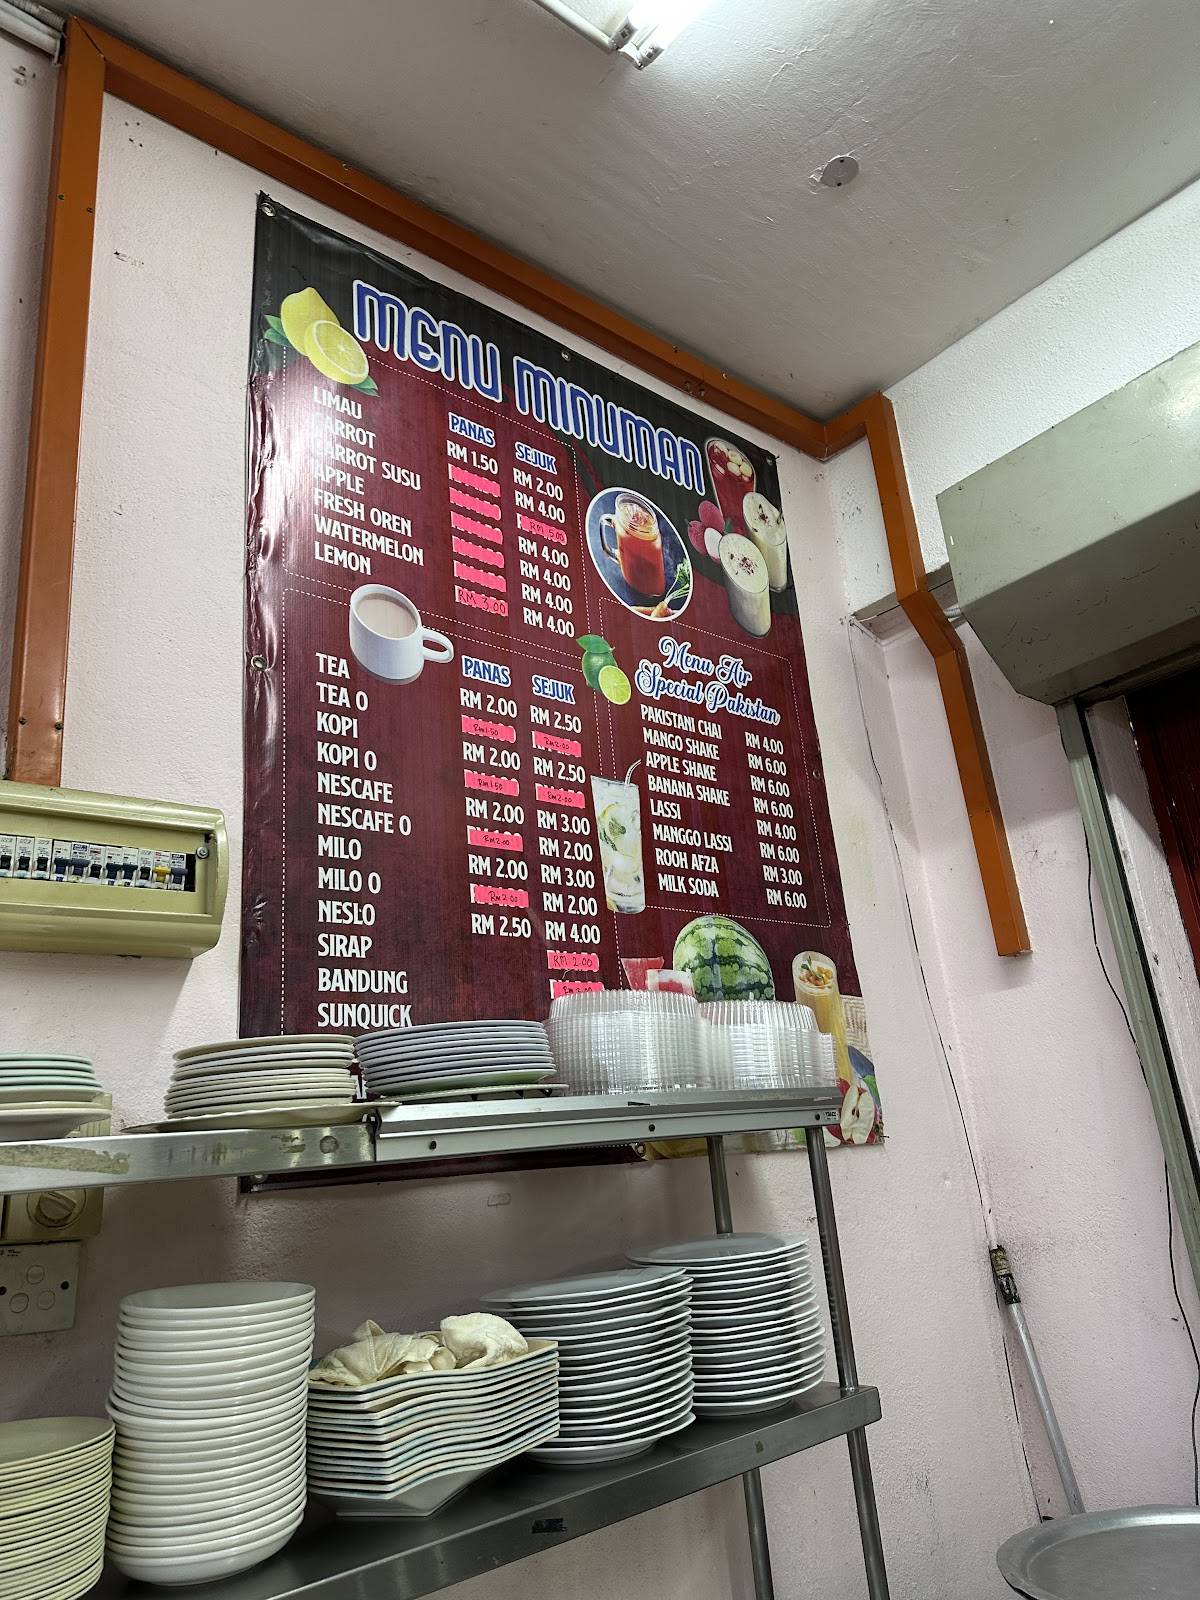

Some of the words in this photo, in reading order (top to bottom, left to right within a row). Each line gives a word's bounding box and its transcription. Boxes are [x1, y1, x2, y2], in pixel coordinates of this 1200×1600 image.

[314, 385, 362, 419] LIMAU
[353, 279, 502, 403] MENU
[513, 356, 705, 496] MINUMAN
[312, 411, 376, 449] CARROT
[448, 411, 496, 448] PANAS
[312, 436, 377, 473] CARROT
[382, 462, 421, 490] SUSU
[447, 440, 468, 463] RM
[471, 451, 498, 474] 1.50
[515, 441, 557, 475] SEJUK
[314, 461, 364, 495] APPLE
[513, 467, 533, 489] RM
[536, 477, 563, 501] 2.00
[314, 488, 365, 521] FRESH
[370, 508, 412, 537] OREN
[515, 490, 534, 512] RM
[538, 501, 565, 523] 4.00
[314, 514, 424, 566] WATERMELON
[519, 536, 537, 557] RM
[542, 546, 569, 568] 4.00
[315, 540, 371, 575] LEMON
[520, 559, 540, 581] RM
[544, 569, 571, 591] 4.00
[459, 590, 476, 605] RM
[521, 583, 541, 604] RM
[545, 592, 572, 614] 4.00
[523, 607, 543, 629] RM
[547, 616, 575, 638] 4.00
[316, 652, 350, 679] TEA
[462, 655, 511, 687] PANAS
[658, 636, 714, 676] Menu
[716, 654, 752, 689] Air
[316, 682, 351, 708] TEA
[355, 691, 368, 711] O
[460, 688, 482, 710] RM
[486, 695, 517, 718] 2.00
[532, 674, 575, 705] SEJUK
[635, 659, 705, 703] Special
[705, 681, 781, 726] Pakistan
[317, 711, 358, 738] KOPI
[530, 705, 550, 726] RM
[554, 712, 581, 733] 2.50
[640, 704, 695, 733] PAKISTANI
[698, 720, 722, 739] CHAI
[317, 741, 359, 768] KOPI
[364, 750, 377, 771] O
[463, 741, 484, 763] RM
[489, 747, 520, 770] 2.00
[643, 727, 683, 751] MANGO
[686, 738, 720, 760] SHAKE
[745, 731, 760, 749] RM
[763, 737, 783, 755] 4.00
[533, 756, 553, 777] RM
[557, 762, 586, 784] 2.50
[646, 751, 680, 773] APPLE
[683, 759, 717, 782] SHAKE
[748, 753, 763, 771] RM
[765, 758, 787, 776] 6.00
[317, 771, 393, 804] NESCAFE
[648, 774, 695, 800] BANANA
[696, 785, 730, 806] SHAKE
[750, 775, 766, 792] RM
[768, 779, 789, 797] 6.00
[317, 802, 394, 834] NESCAFE
[399, 815, 411, 836] O
[465, 797, 488, 819] RM
[492, 802, 524, 824] 2.00
[537, 809, 557, 830] RM
[561, 813, 590, 835] 3.00
[650, 798, 681, 820] LASSI
[753, 797, 769, 815] RM
[771, 801, 793, 819] 6.00
[652, 823, 701, 847] MANGGO
[704, 832, 733, 852] LASSI
[756, 819, 772, 837] RM
[775, 823, 796, 841] 4.00
[318, 834, 361, 860] MILO
[539, 836, 559, 858] RM
[564, 841, 593, 862] 2.00
[655, 848, 688, 869] ROOH
[691, 853, 719, 873] AFZA
[759, 842, 775, 859] RM
[778, 846, 800, 863] 6.00
[318, 866, 362, 892] MILO
[368, 872, 381, 894] O
[468, 854, 491, 877] RM
[496, 858, 528, 880] 2.00
[541, 864, 561, 885] RM
[565, 867, 595, 889] 3.00
[763, 865, 778, 883] RM
[782, 868, 802, 886] 3.00
[658, 873, 686, 893] MILK
[689, 877, 719, 897] SODA
[766, 888, 782, 906] RM
[785, 891, 807, 909] 6.00
[318, 900, 376, 926] NESLO
[542, 891, 564, 913] RM
[568, 894, 598, 916] 2.00
[471, 913, 494, 936] RM
[499, 916, 531, 938] 2.50
[545, 920, 566, 942] RM
[570, 923, 600, 945] 4.00
[318, 933, 372, 958] SIRAP
[318, 967, 408, 994] BANDUNG
[318, 1002, 412, 1029] SUNQUICK
